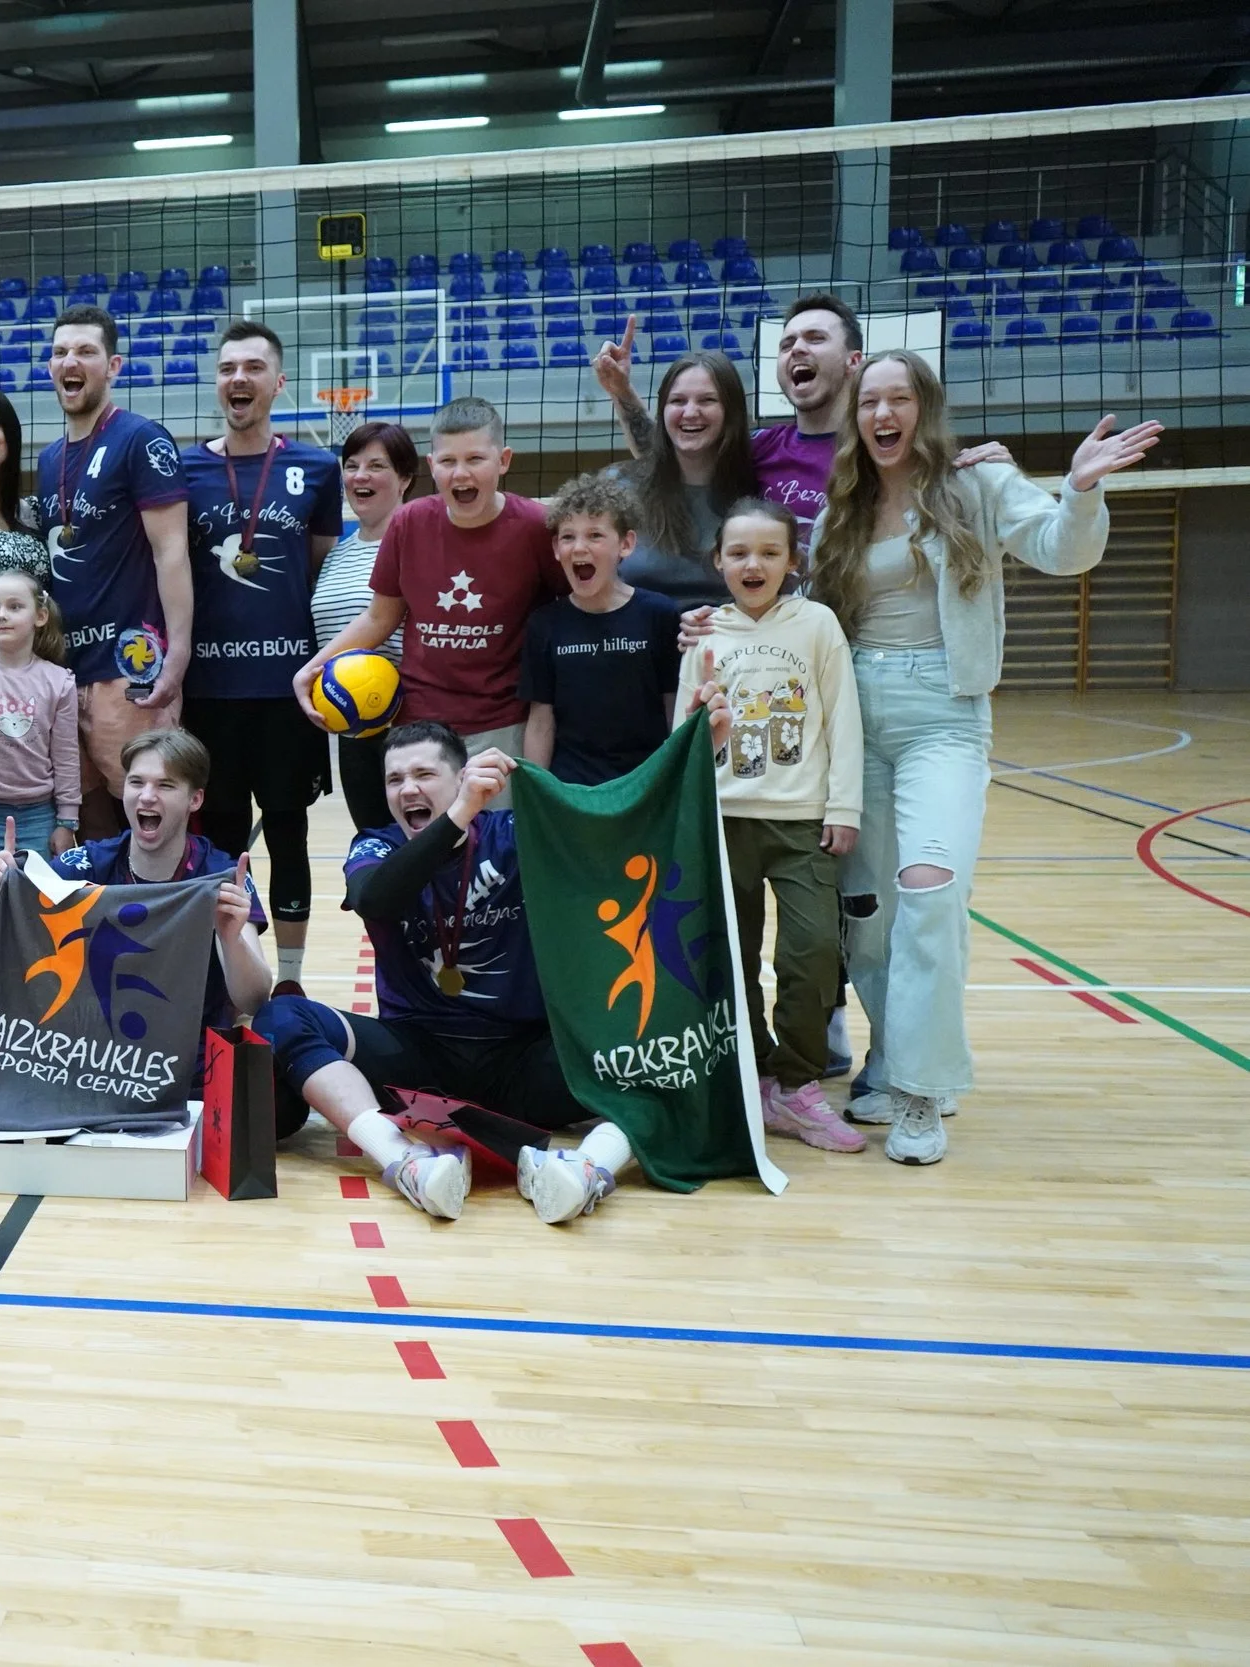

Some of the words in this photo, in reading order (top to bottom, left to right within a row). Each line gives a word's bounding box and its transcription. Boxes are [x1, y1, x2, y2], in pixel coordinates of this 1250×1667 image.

[87, 446, 107, 478] 4
[286, 466, 305, 495] 8
[71, 622, 116, 648] BŪVE
[196, 642, 221, 658] SIA
[223, 641, 260, 657] GKG
[263, 636, 309, 656] BŪVE
[421, 635, 488, 649] LATVIJA
[557, 643, 599, 656] tommy
[603, 637, 648, 653] hilfiger
[714, 644, 807, 674] T-PUCCINO
[76, 1073, 160, 1102] CENTRS
